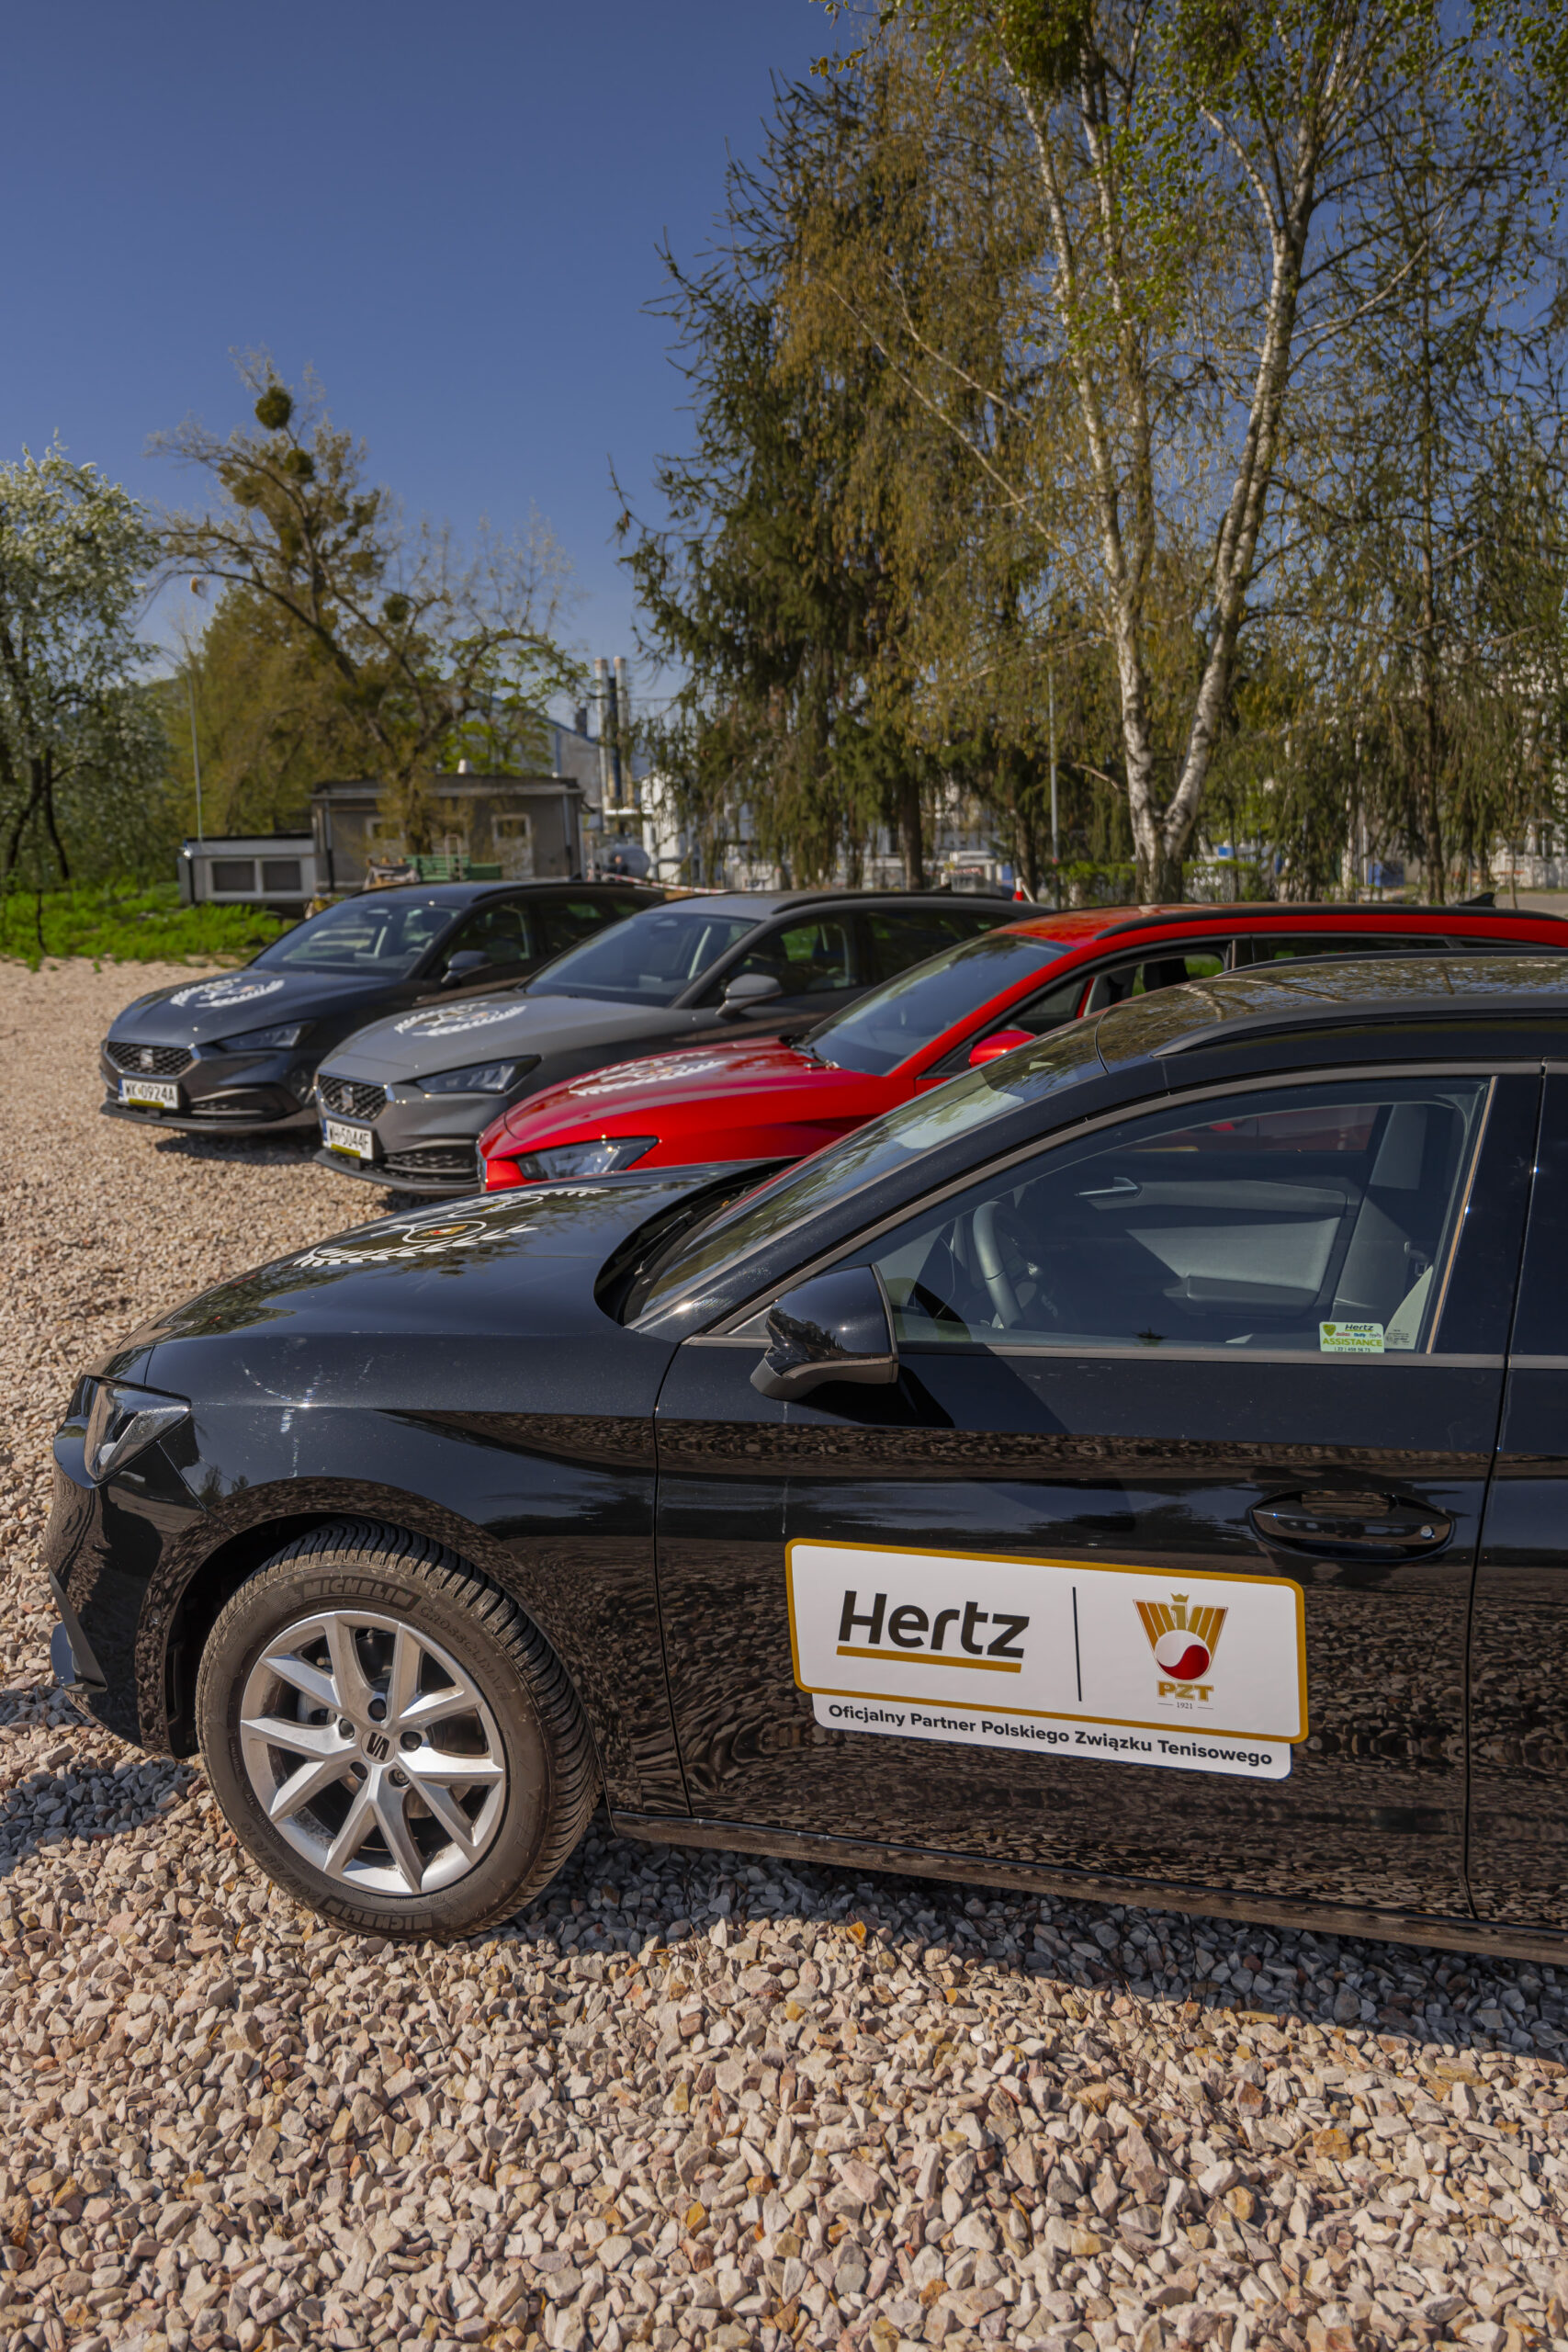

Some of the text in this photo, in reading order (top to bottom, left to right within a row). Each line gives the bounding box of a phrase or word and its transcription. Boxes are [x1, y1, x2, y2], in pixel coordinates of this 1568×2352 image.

[141, 1084, 175, 1102] 0924A
[1323, 1338, 1382, 1347] ASSISTANCE
[302, 1578, 416, 1608] MICHELIN
[838, 1589, 1031, 1659] Hertz
[420, 1605, 513, 1702] CROSSCLIMATE
[1156, 1680, 1214, 1702] PZT
[1177, 1702, 1193, 1710] 1921
[829, 1703, 1273, 1768] Oficjalny Partner Polskiego Związku Tenisowego
[323, 1898, 434, 1931] MICHELIN
